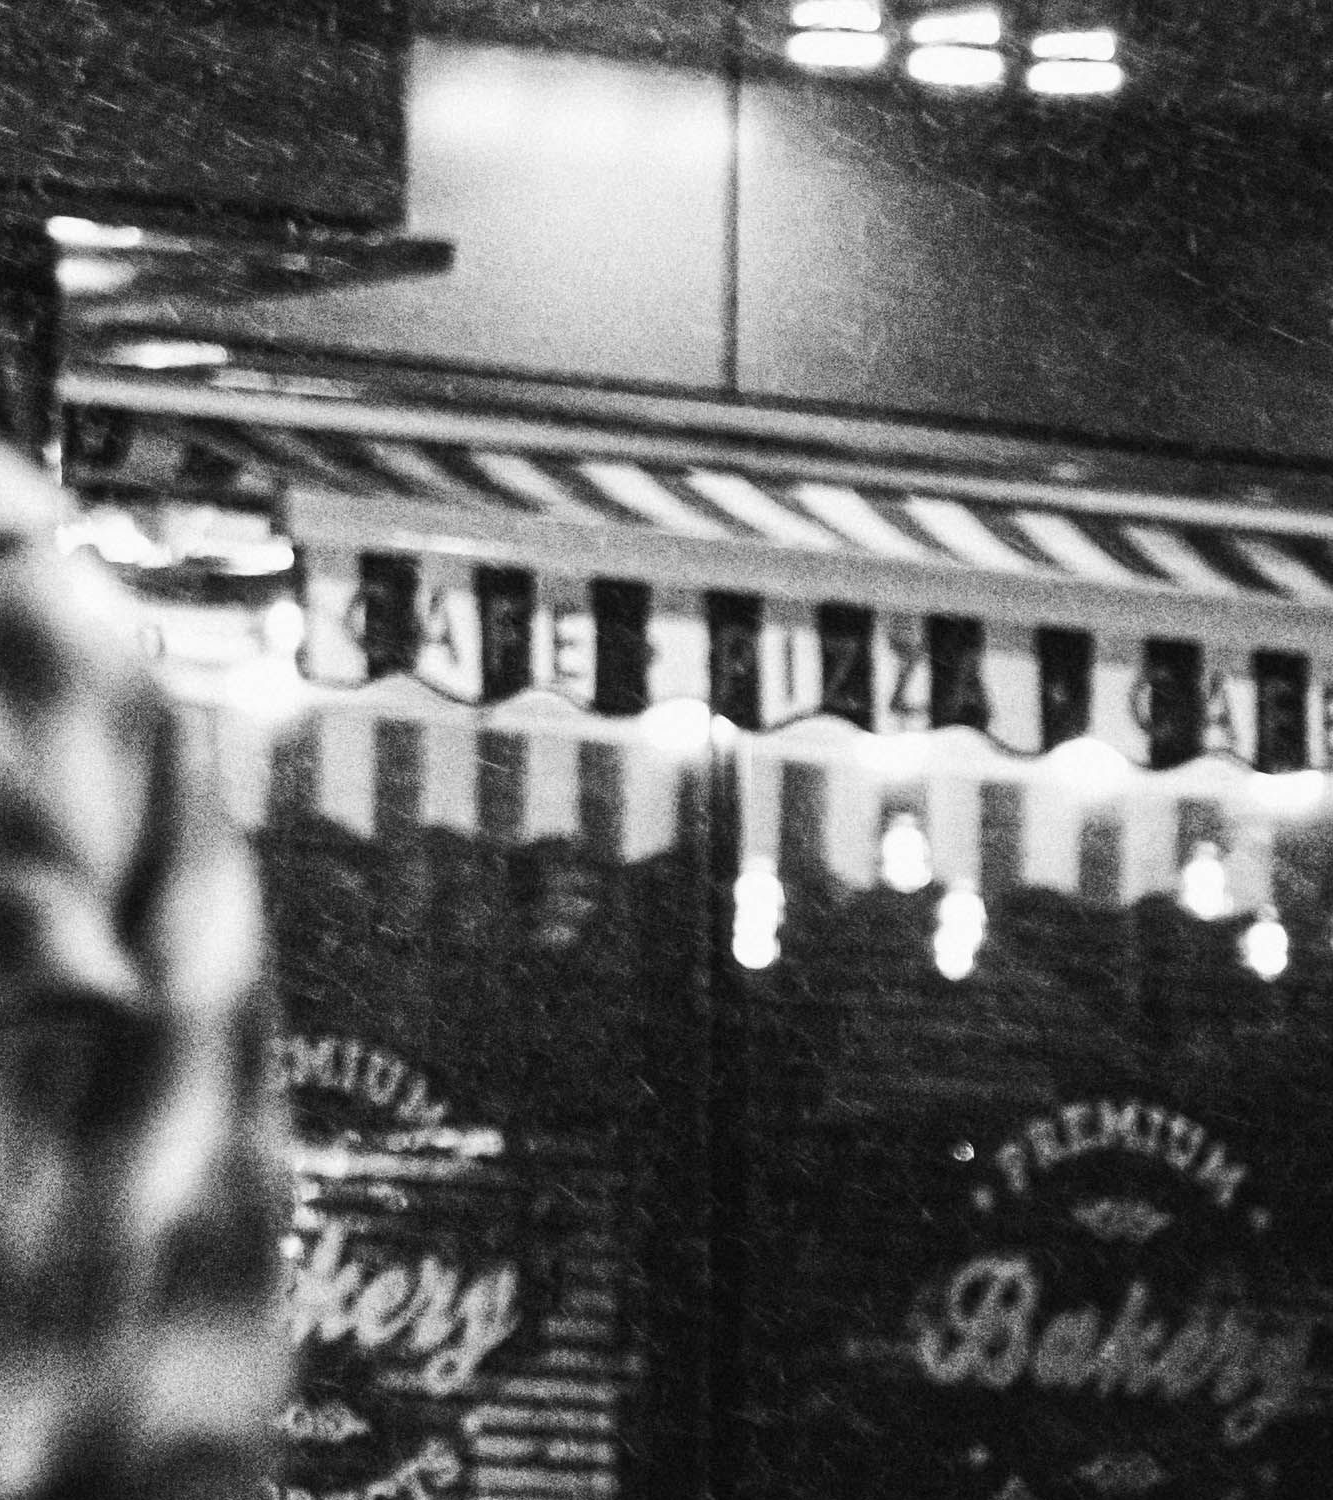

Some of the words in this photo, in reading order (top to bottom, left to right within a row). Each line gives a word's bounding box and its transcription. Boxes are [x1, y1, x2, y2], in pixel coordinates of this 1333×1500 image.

[345, 579, 585, 680] CAFE
[717, 624, 991, 724] PIZZA
[994, 1100, 1249, 1207] PREMIUM
[913, 1257, 1311, 1446] Bakery
